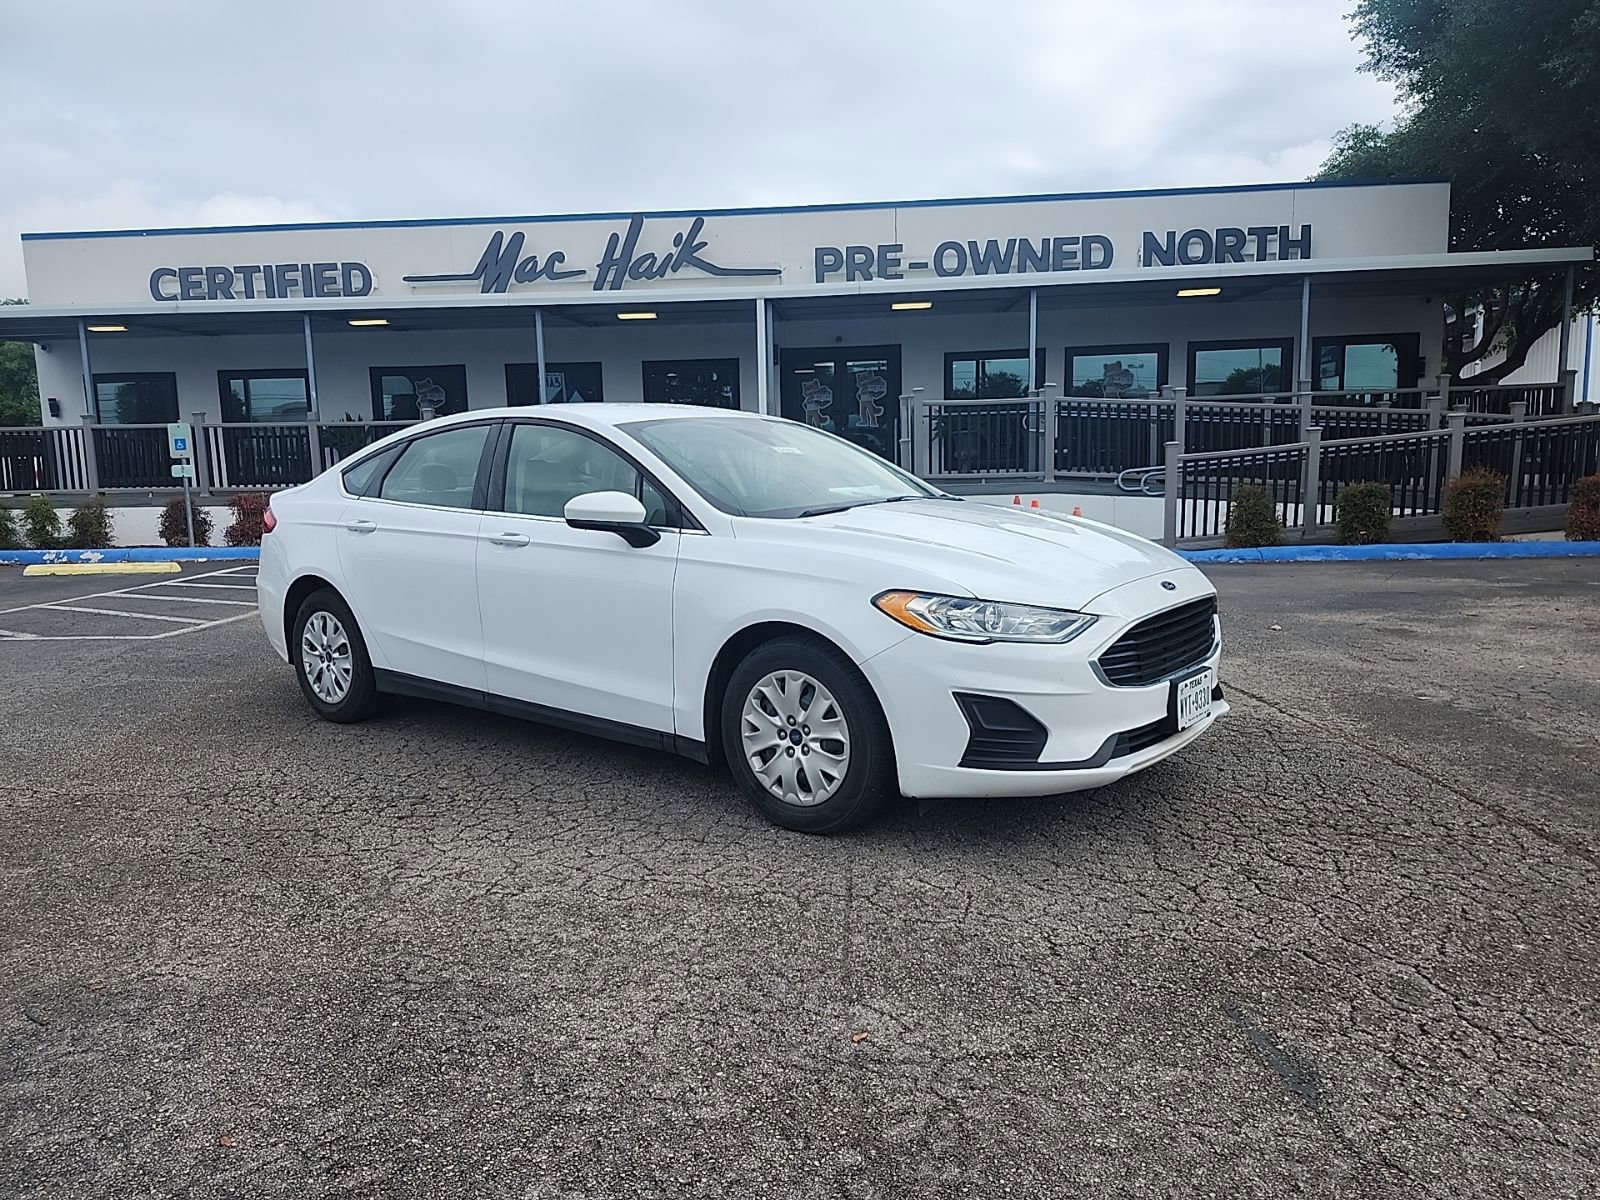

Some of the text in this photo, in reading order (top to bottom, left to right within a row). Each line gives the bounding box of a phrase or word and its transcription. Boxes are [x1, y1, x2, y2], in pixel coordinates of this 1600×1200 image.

[402, 212, 782, 294] Mac Haik
[814, 224, 1313, 284] PRE-OWNED NORTH
[149, 262, 373, 302] CERTIFIED
[1189, 676, 1203, 690] TEXAS
